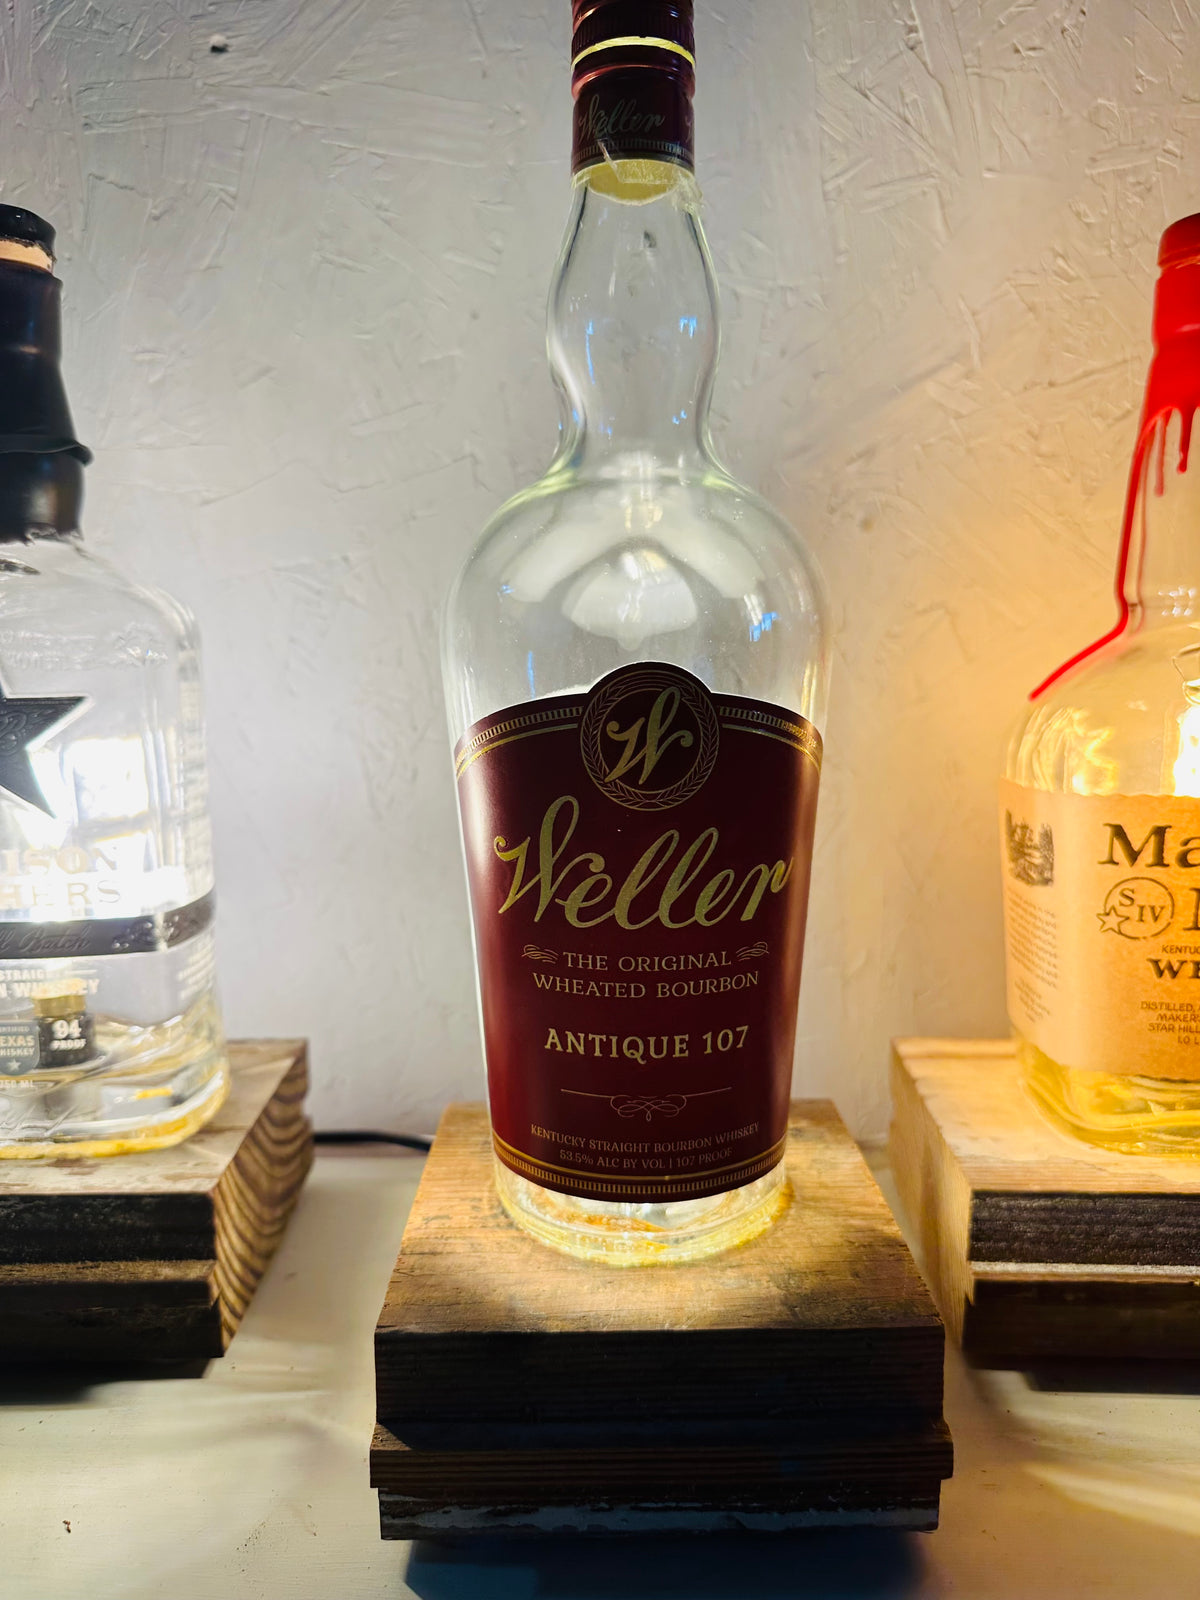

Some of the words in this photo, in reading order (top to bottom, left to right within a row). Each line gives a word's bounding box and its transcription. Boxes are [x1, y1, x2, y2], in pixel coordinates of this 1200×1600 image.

[578, 94, 665, 144] Weller
[494, 795, 794, 930] Weller
[563, 951, 609, 971] THE
[618, 951, 732, 972] ORIGINAL
[532, 972, 646, 998] WHEATED
[656, 970, 760, 998] BOURBON
[52, 1019, 82, 1039] 94
[1148, 1023, 1175, 1033] STAR
[49, 1039, 87, 1051] PROOF
[544, 1027, 690, 1065] ANTIQUE
[702, 1025, 750, 1055] 107
[530, 1123, 586, 1148] KENTUCKY
[589, 1139, 650, 1153] STRAIGHT
[654, 1138, 712, 1153] BOURBON
[715, 1121, 760, 1145] WHISKEY
[559, 1149, 594, 1166] 53.5%
[597, 1157, 620, 1168] ALC
[623, 1158, 638, 1169] BY
[642, 1157, 666, 1169] VOL
[677, 1154, 696, 1167] 107
[699, 1149, 733, 1164] PROOF
